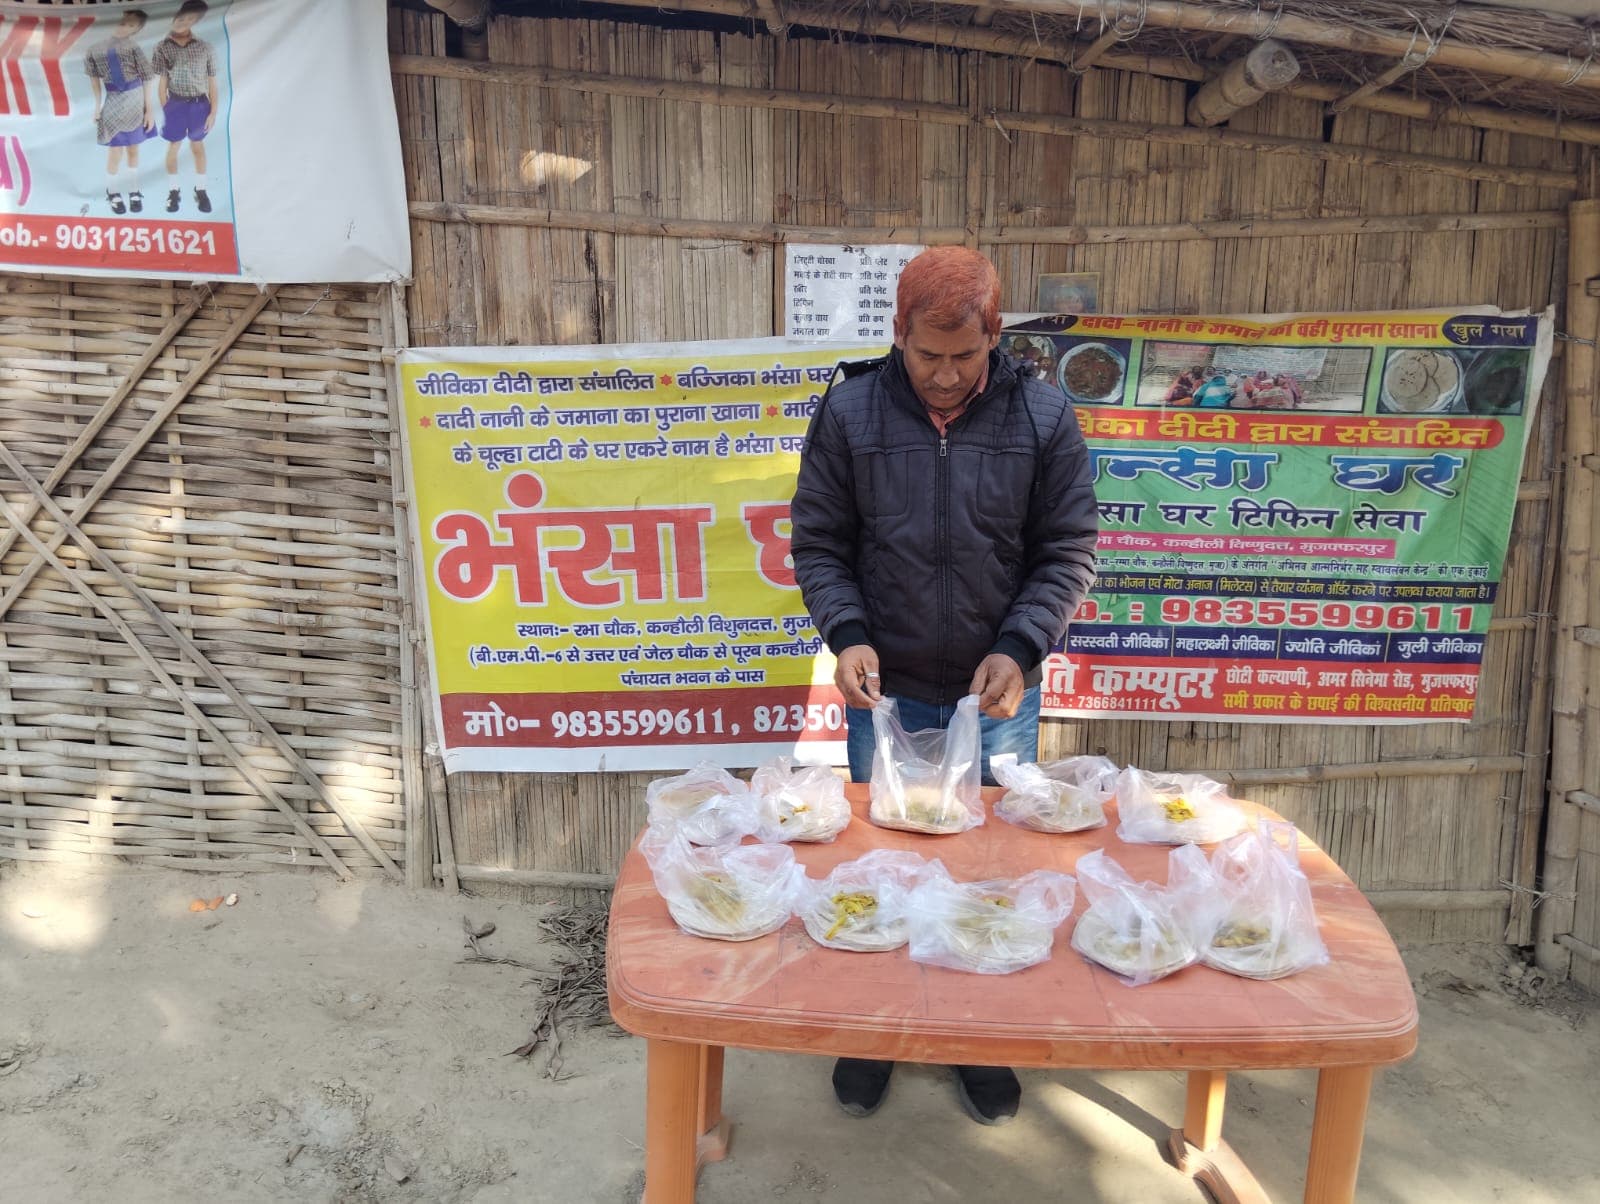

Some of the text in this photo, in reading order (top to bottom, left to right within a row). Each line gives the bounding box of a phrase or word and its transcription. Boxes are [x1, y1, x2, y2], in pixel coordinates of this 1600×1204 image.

[56, 224, 217, 256] 9031251621
[860, 256, 872, 266] प्रति
[874, 257, 888, 266] प्लेट
[813, 269, 822, 279] के
[860, 271, 872, 280] प्रति
[874, 271, 887, 280] प्लेट
[859, 285, 871, 295] प्रति
[874, 285, 887, 295] प्लेट
[858, 299, 871, 308] प्रति
[873, 299, 893, 309] टिफिन
[815, 314, 829, 322] चाय
[858, 313, 870, 323] प्रति
[871, 315, 884, 323] कप
[857, 328, 870, 337] प्रति
[871, 329, 884, 337] कप
[1208, 323, 1265, 340] जमाने
[1269, 323, 1293, 337] का
[1297, 319, 1329, 338] वही
[1332, 322, 1386, 343] पुराना
[1388, 323, 1438, 339] खाना
[1451, 323, 1527, 344] खुल गया
[416, 373, 489, 396] जीविका
[493, 372, 532, 394] दीदी
[537, 377, 574, 395] द्वारा
[578, 369, 655, 392] संचालित
[761, 363, 802, 385] भंसा
[807, 368, 834, 384] घर
[437, 407, 476, 429] दादी
[480, 405, 524, 428] नानी
[530, 405, 551, 427] के
[554, 408, 619, 427] जमाना
[624, 407, 649, 424] का
[654, 405, 706, 430] पुराना
[711, 404, 760, 421] खाना
[1158, 413, 1240, 439] दीदी
[1248, 422, 1325, 447] द्वारा
[1334, 419, 1492, 446] संचालित
[453, 442, 473, 464] के
[478, 446, 522, 470] चूल्हा
[528, 438, 563, 461] टाटी
[568, 438, 588, 460] के
[593, 444, 620, 460] घर
[625, 436, 668, 459] एकरे
[672, 439, 710, 457] नाम
[715, 433, 730, 457] है
[735, 433, 774, 455] भंसा
[1331, 453, 1465, 499] घर
[1159, 504, 1217, 529] घर
[1228, 496, 1341, 533] टिफिन
[1353, 502, 1428, 535] सेवा
[434, 472, 714, 608] भंसा
[1162, 536, 1225, 550] कन्हौली
[1231, 557, 1240, 570] के
[1451, 565, 1465, 579] एक
[1105, 578, 1117, 589] का
[1119, 574, 1146, 590] भोजन
[1148, 575, 1162, 591] एवं
[1185, 578, 1213, 592] अनाज
[1352, 580, 1376, 598] करने
[1379, 586, 1393, 599] पर
[1426, 586, 1456, 599] कराया
[1456, 587, 1478, 600] जाता
[1161, 596, 1474, 633] 9835599611
[574, 622, 600, 638] रभा
[604, 617, 641, 637] चौक,
[646, 616, 704, 635] कन्हौली
[783, 616, 813, 637] मुज
[566, 645, 580, 663] से
[584, 649, 615, 663] उत्तर
[619, 644, 642, 663] एवं
[643, 643, 674, 662] जेल
[678, 642, 709, 660] चौक
[713, 642, 728, 660] से
[765, 638, 823, 657] कन्हौली
[1070, 632, 1169, 650] सरस्वती जीविका
[1175, 633, 1275, 653] महालक्ष्मी जीविका
[1285, 636, 1326, 655] ज्योति
[1397, 637, 1483, 659] जुली जीविका
[620, 667, 765, 686] पंचायत भवन के पास
[1090, 664, 1219, 710] कम्प्यूटर
[1226, 664, 1252, 686] छोटी
[1257, 667, 1312, 689] कल्याणी,
[1318, 671, 1348, 688] अमर
[1351, 668, 1389, 688] सिनेमा
[1392, 668, 1415, 692] रोड,
[1077, 694, 1157, 711] 7366841111
[1223, 690, 1249, 710] सभी
[1252, 694, 1286, 711] प्रकार
[1289, 691, 1304, 710] के
[1307, 692, 1342, 712] छपाई
[1343, 692, 1360, 712] की
[1365, 694, 1427, 714] विश्वसनीय
[550, 705, 742, 740] 9835599611,
